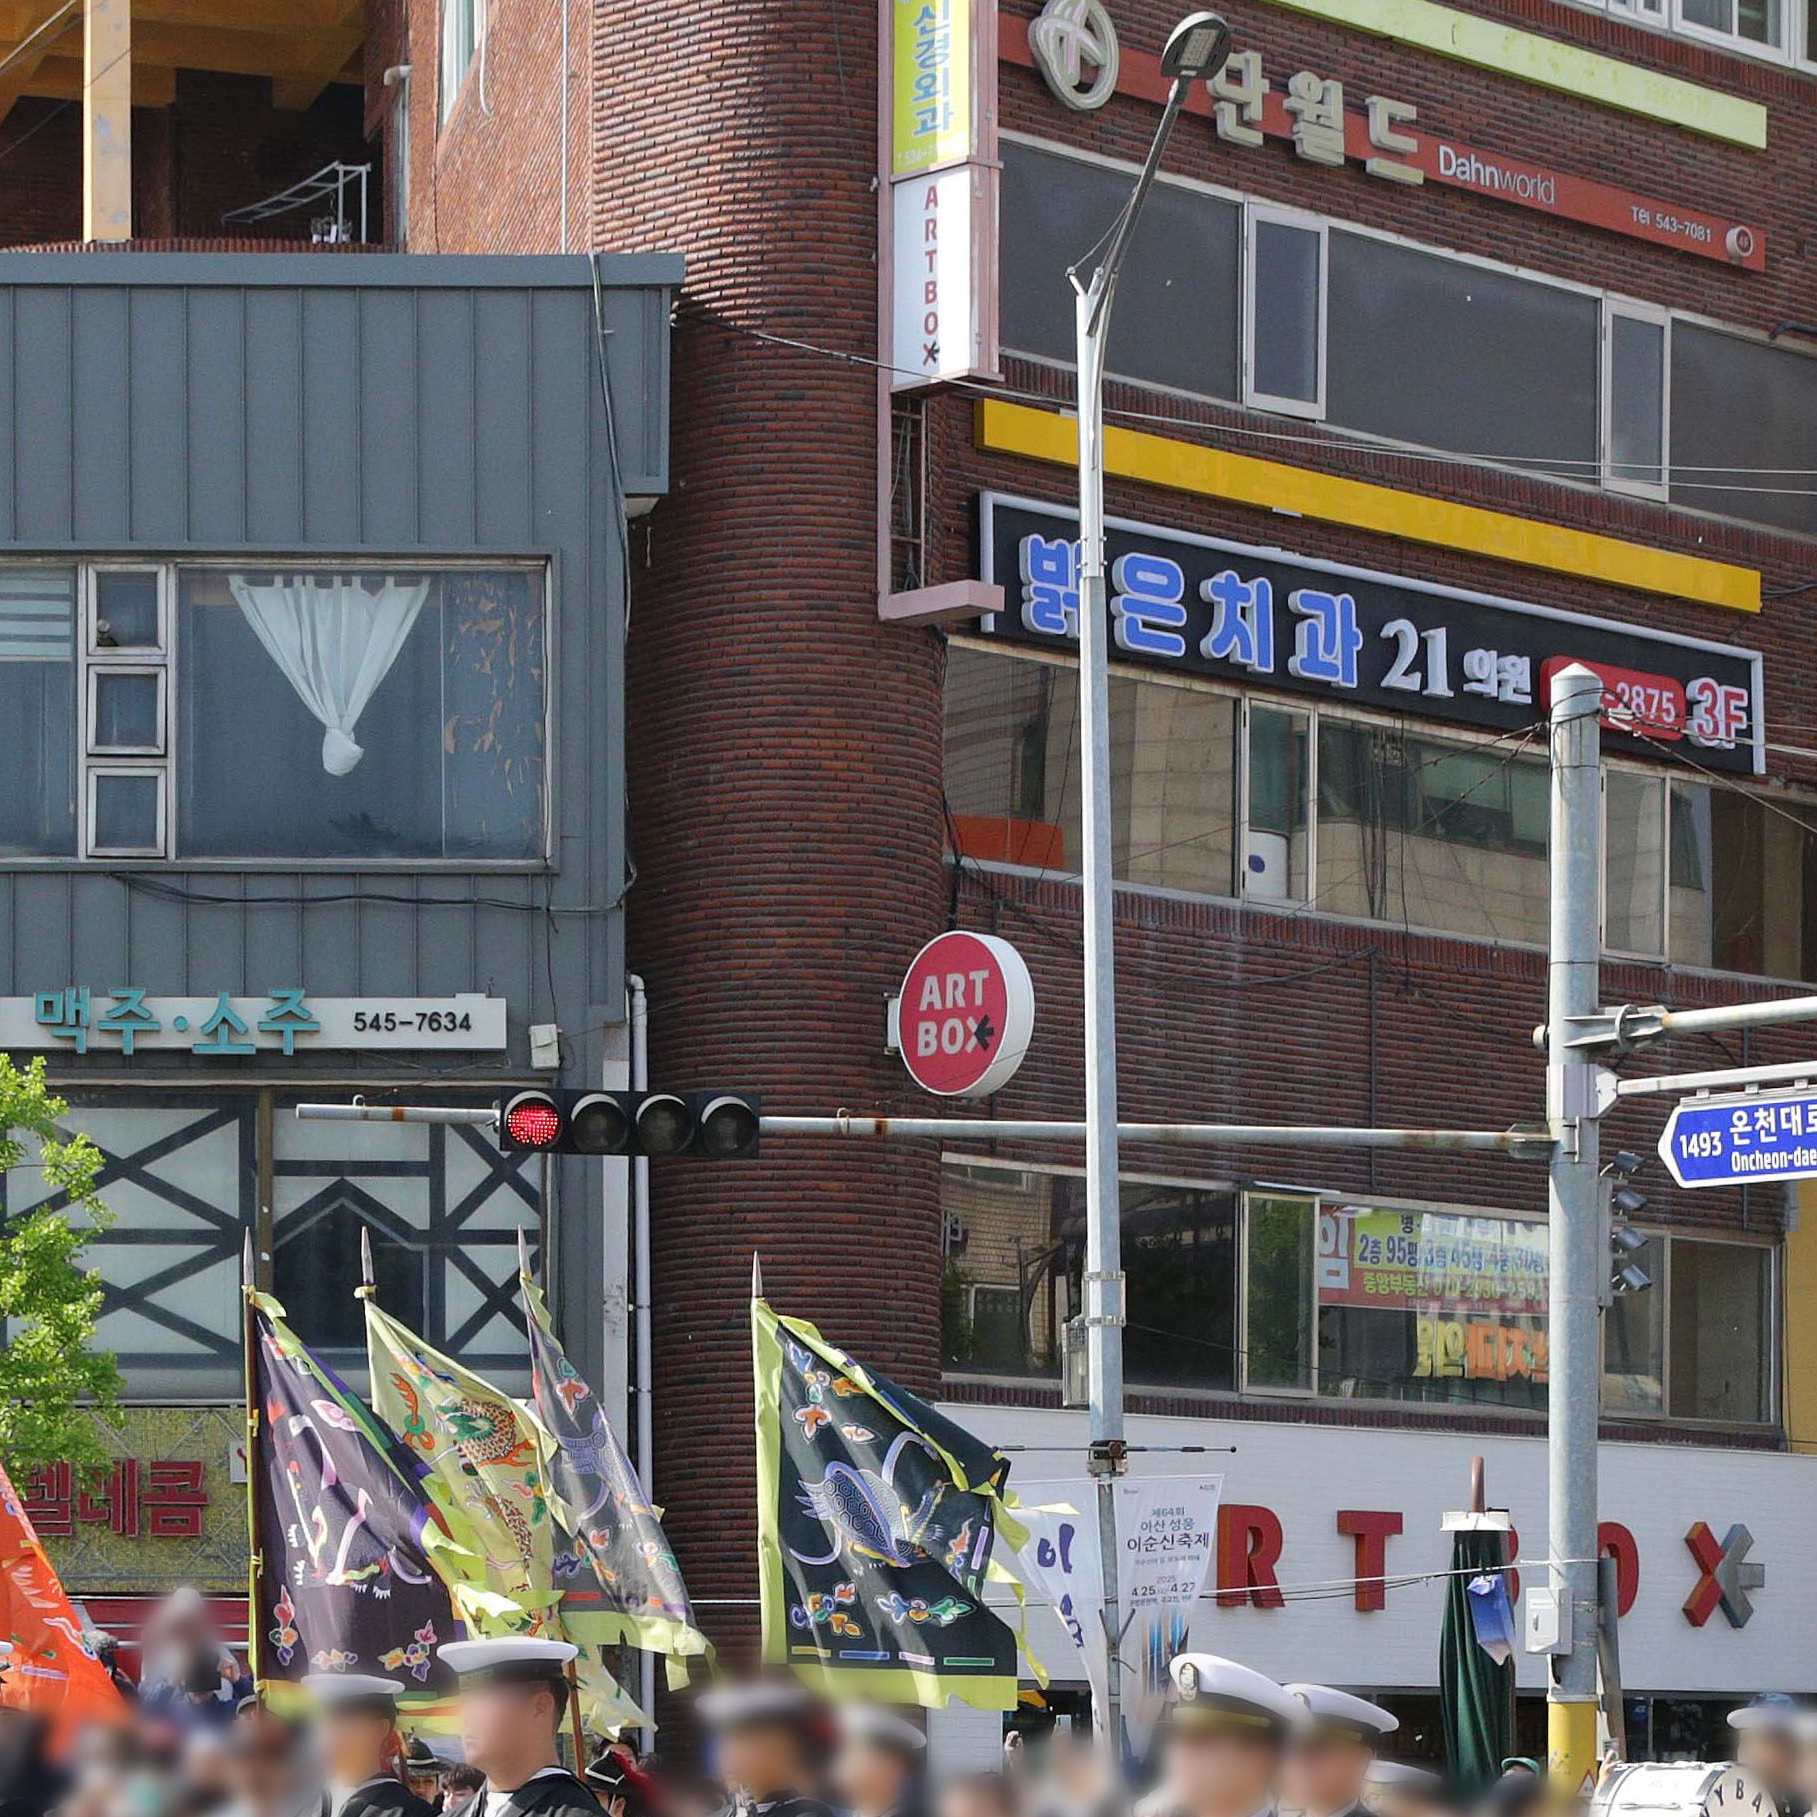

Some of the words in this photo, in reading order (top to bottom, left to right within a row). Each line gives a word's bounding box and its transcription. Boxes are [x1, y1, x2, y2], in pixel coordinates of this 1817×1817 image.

[1206, 50, 1425, 186] 단월드
[1437, 144, 1557, 206] Dahnworld
[1630, 205, 1651, 226] Tel
[1655, 212, 1712, 243] 543-7081
[922, 184, 940, 367] ARTBOX
[1019, 532, 1363, 689] 밝은치과
[1380, 618, 1455, 699] 21
[1462, 648, 1532, 705] 의원
[1686, 677, 1748, 750] 3F
[919, 969, 990, 1012] ART
[352, 1010, 473, 1034] 545-7634
[917, 1014, 995, 1057] BOX
[1679, 1131, 1722, 1159] 1493
[1358, 1233, 1382, 1265] 2층
[1127, 1532, 1210, 1553] 이순신축제
